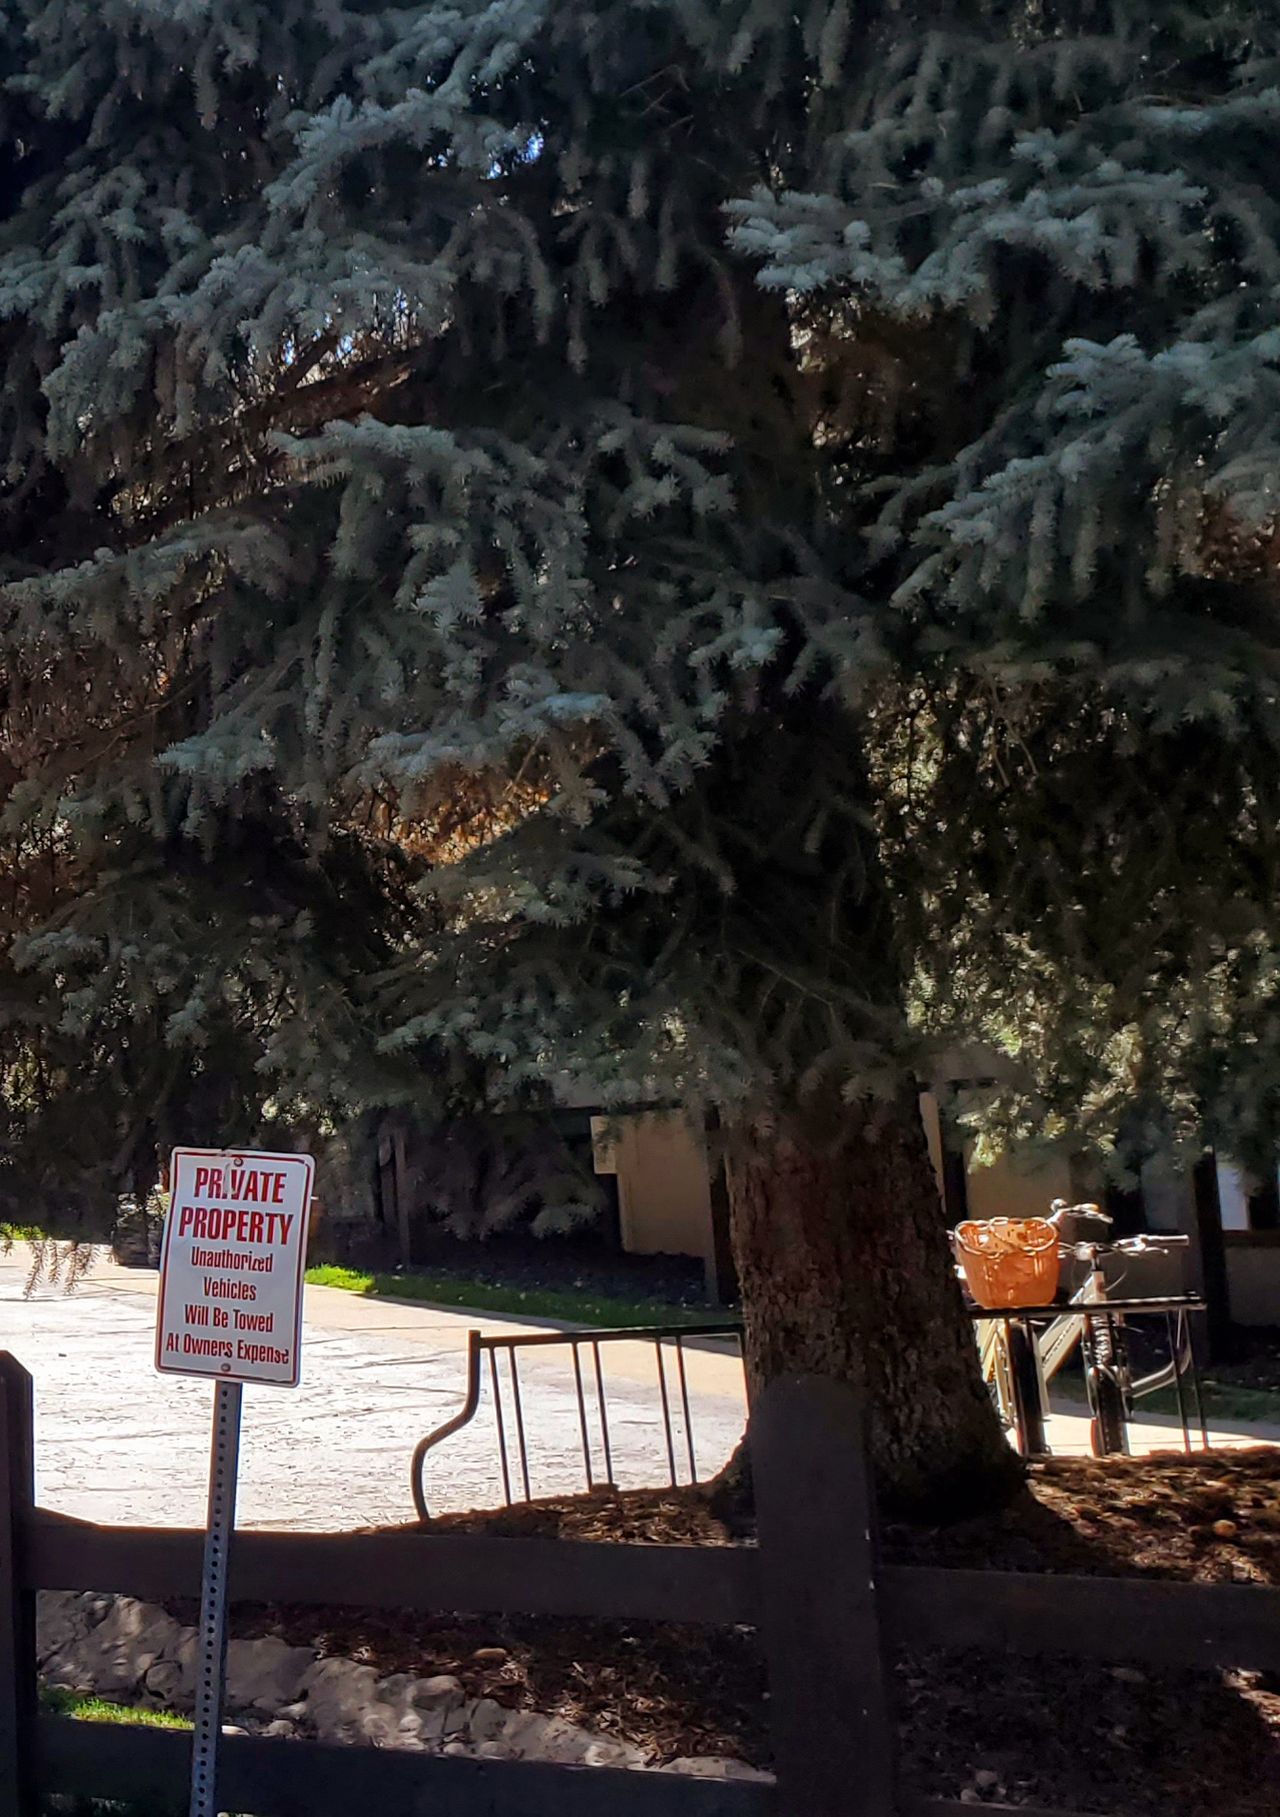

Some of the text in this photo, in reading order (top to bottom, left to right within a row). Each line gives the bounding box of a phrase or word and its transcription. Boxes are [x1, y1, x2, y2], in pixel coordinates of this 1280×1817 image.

[178, 1207, 294, 1246] PROPERTY
[191, 1246, 273, 1272] Unauthorized
[203, 1277, 257, 1301] Vehicles
[185, 1304, 274, 1333] Will Be Towed
[166, 1333, 290, 1365] At Owners Expense
